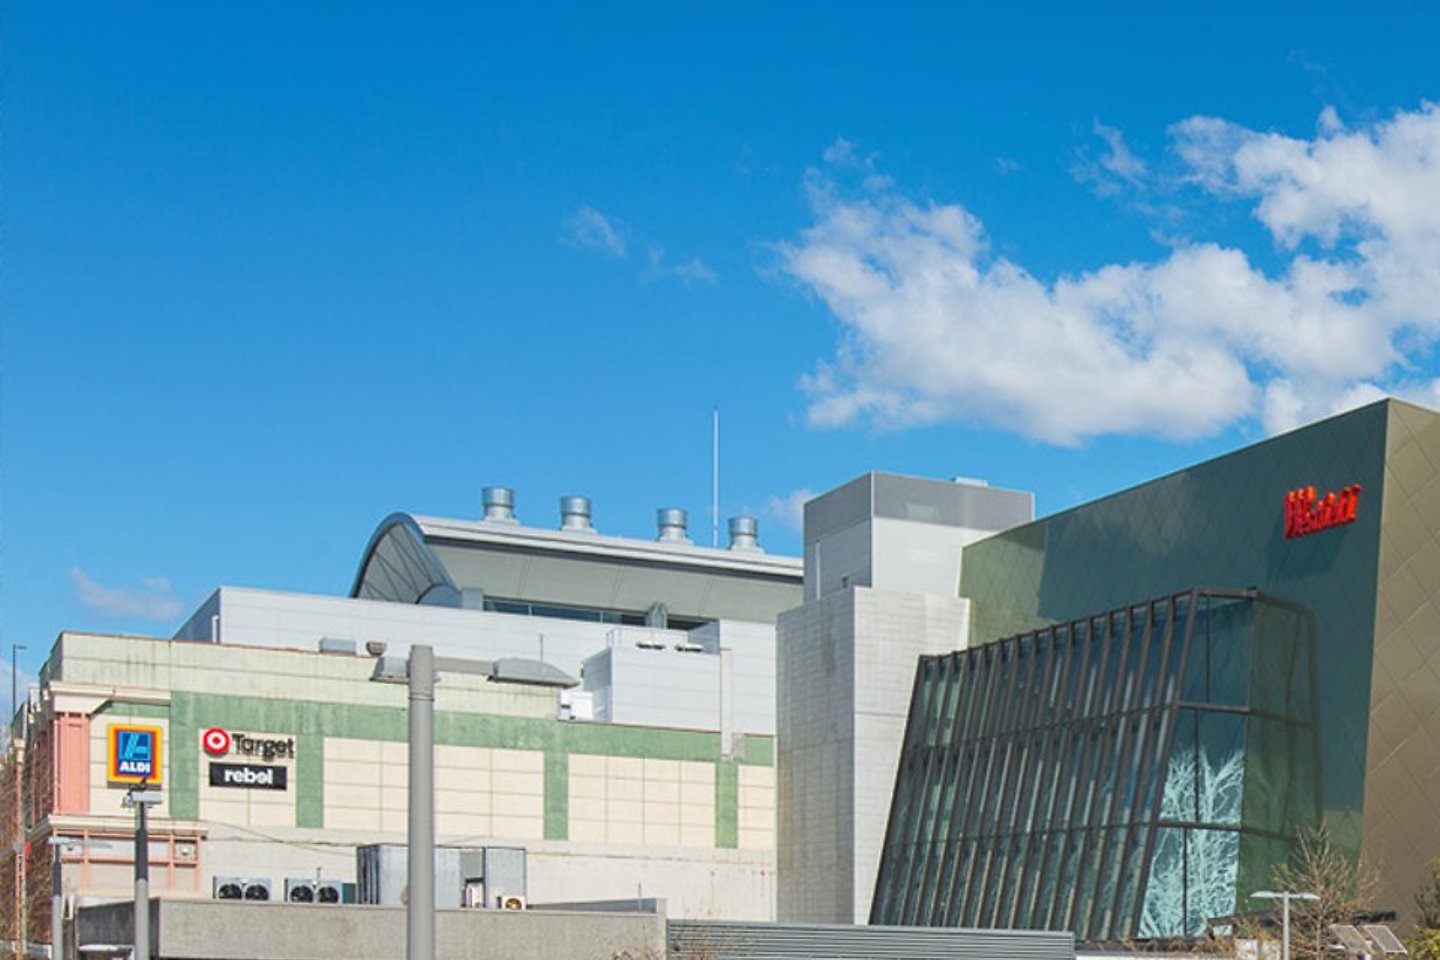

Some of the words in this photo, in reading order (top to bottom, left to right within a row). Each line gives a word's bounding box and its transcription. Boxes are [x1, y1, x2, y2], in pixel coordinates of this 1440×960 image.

[232, 733, 294, 761] Target
[119, 761, 151, 773] ALDI
[224, 768, 273, 784] rebel
